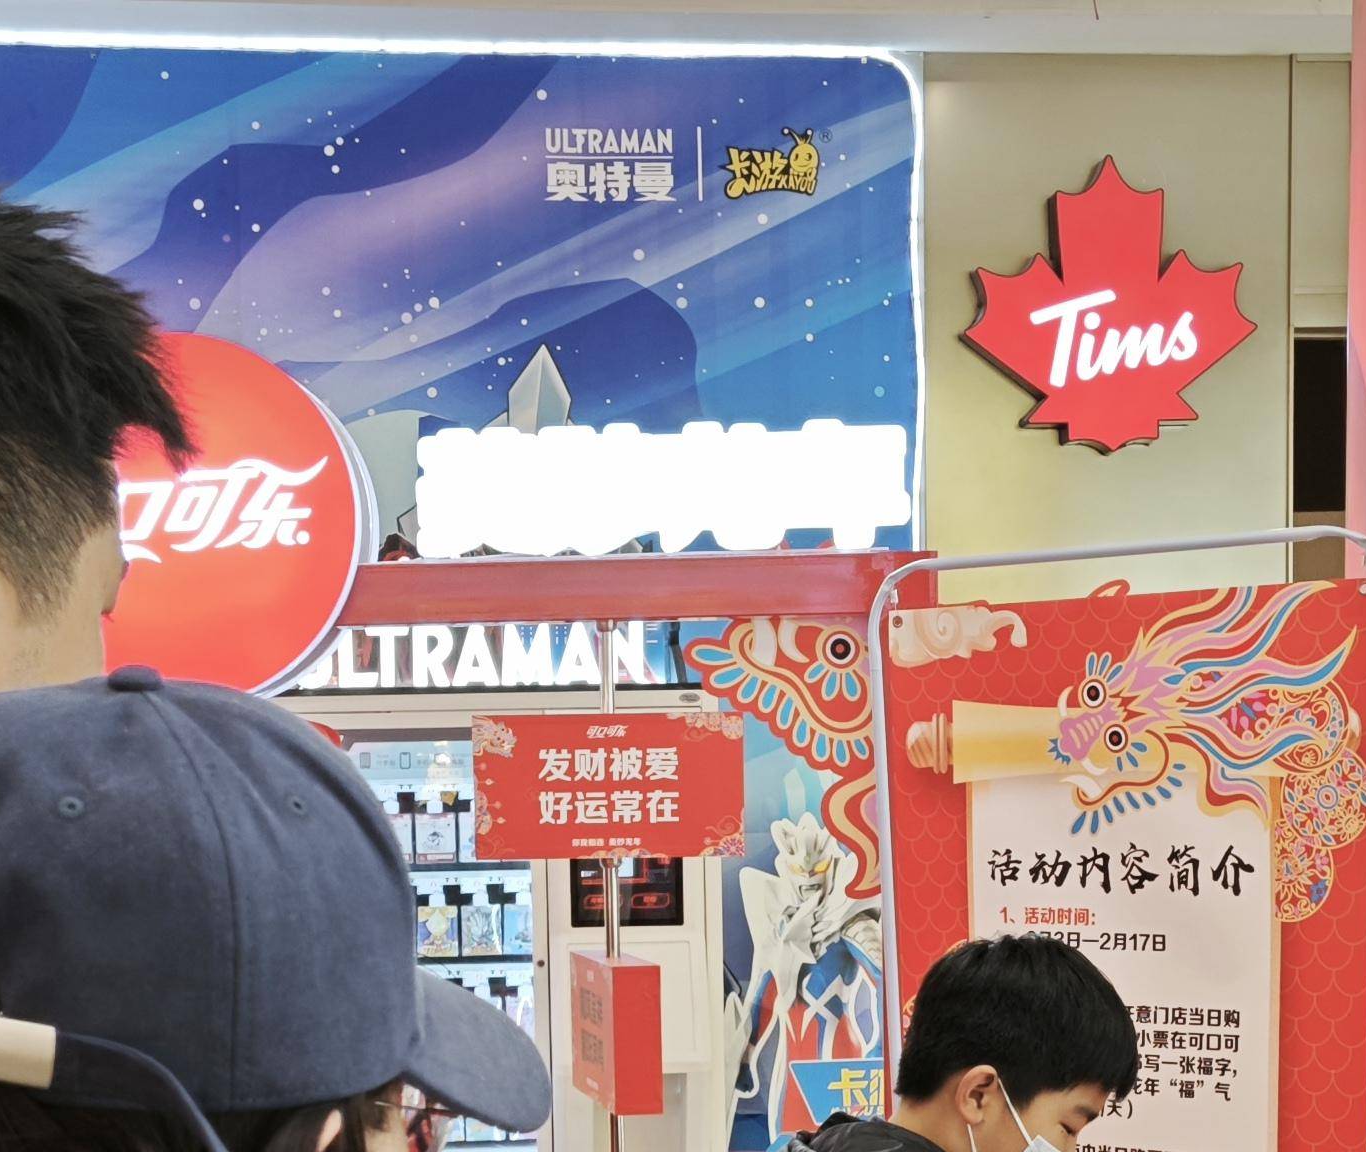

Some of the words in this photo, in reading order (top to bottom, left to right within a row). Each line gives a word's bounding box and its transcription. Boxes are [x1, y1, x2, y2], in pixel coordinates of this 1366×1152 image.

[545, 127, 674, 155] ULTRAMAN
[544, 161, 677, 204] 奥特曼
[1030, 289, 1199, 389] Tims
[586, 724, 629, 739] 可口可乐
[538, 746, 679, 782] 发财被爱
[538, 789, 680, 825] 好运常在
[987, 842, 1255, 897] 活动内容简介
